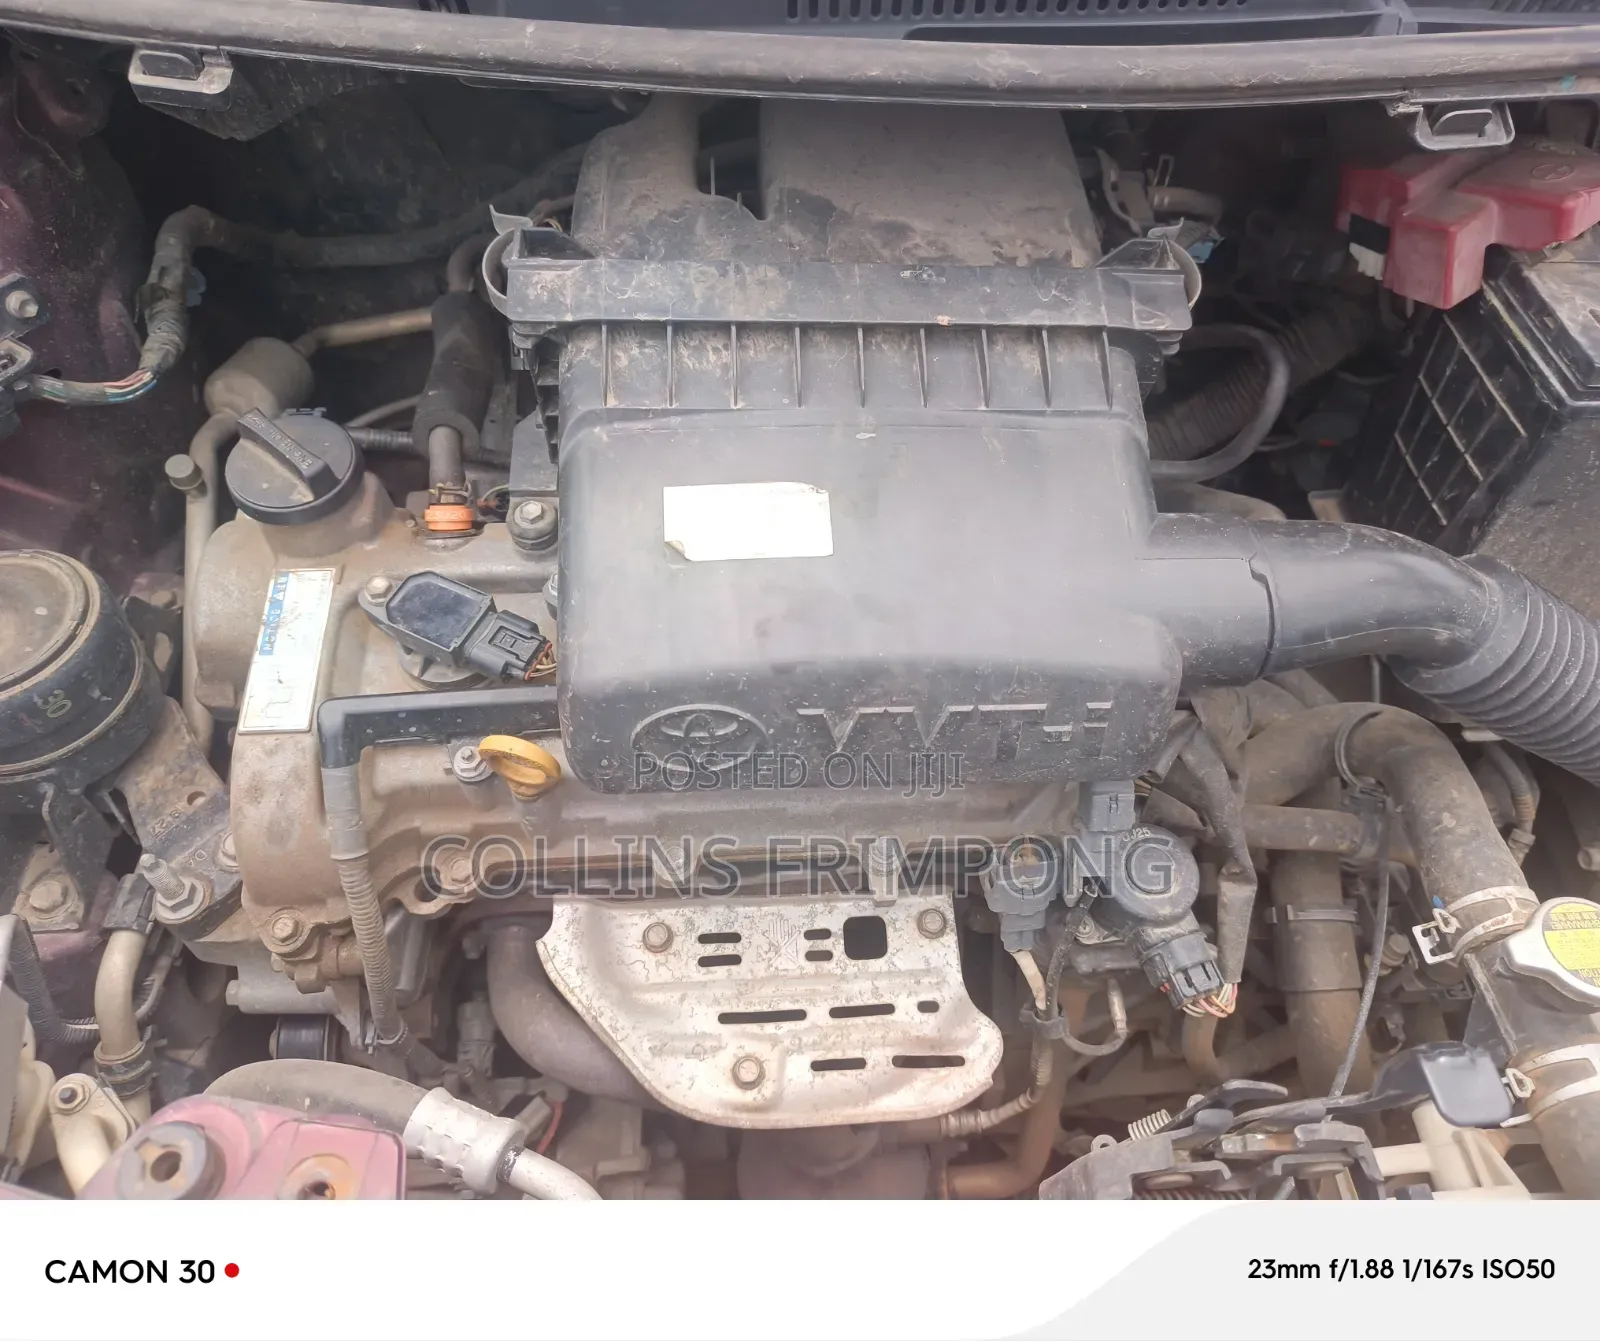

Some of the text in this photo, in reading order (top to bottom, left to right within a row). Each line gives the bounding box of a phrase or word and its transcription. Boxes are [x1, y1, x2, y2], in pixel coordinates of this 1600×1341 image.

[267, 428, 313, 469] ENGINE OIL
[263, 608, 281, 651] NOTICE
